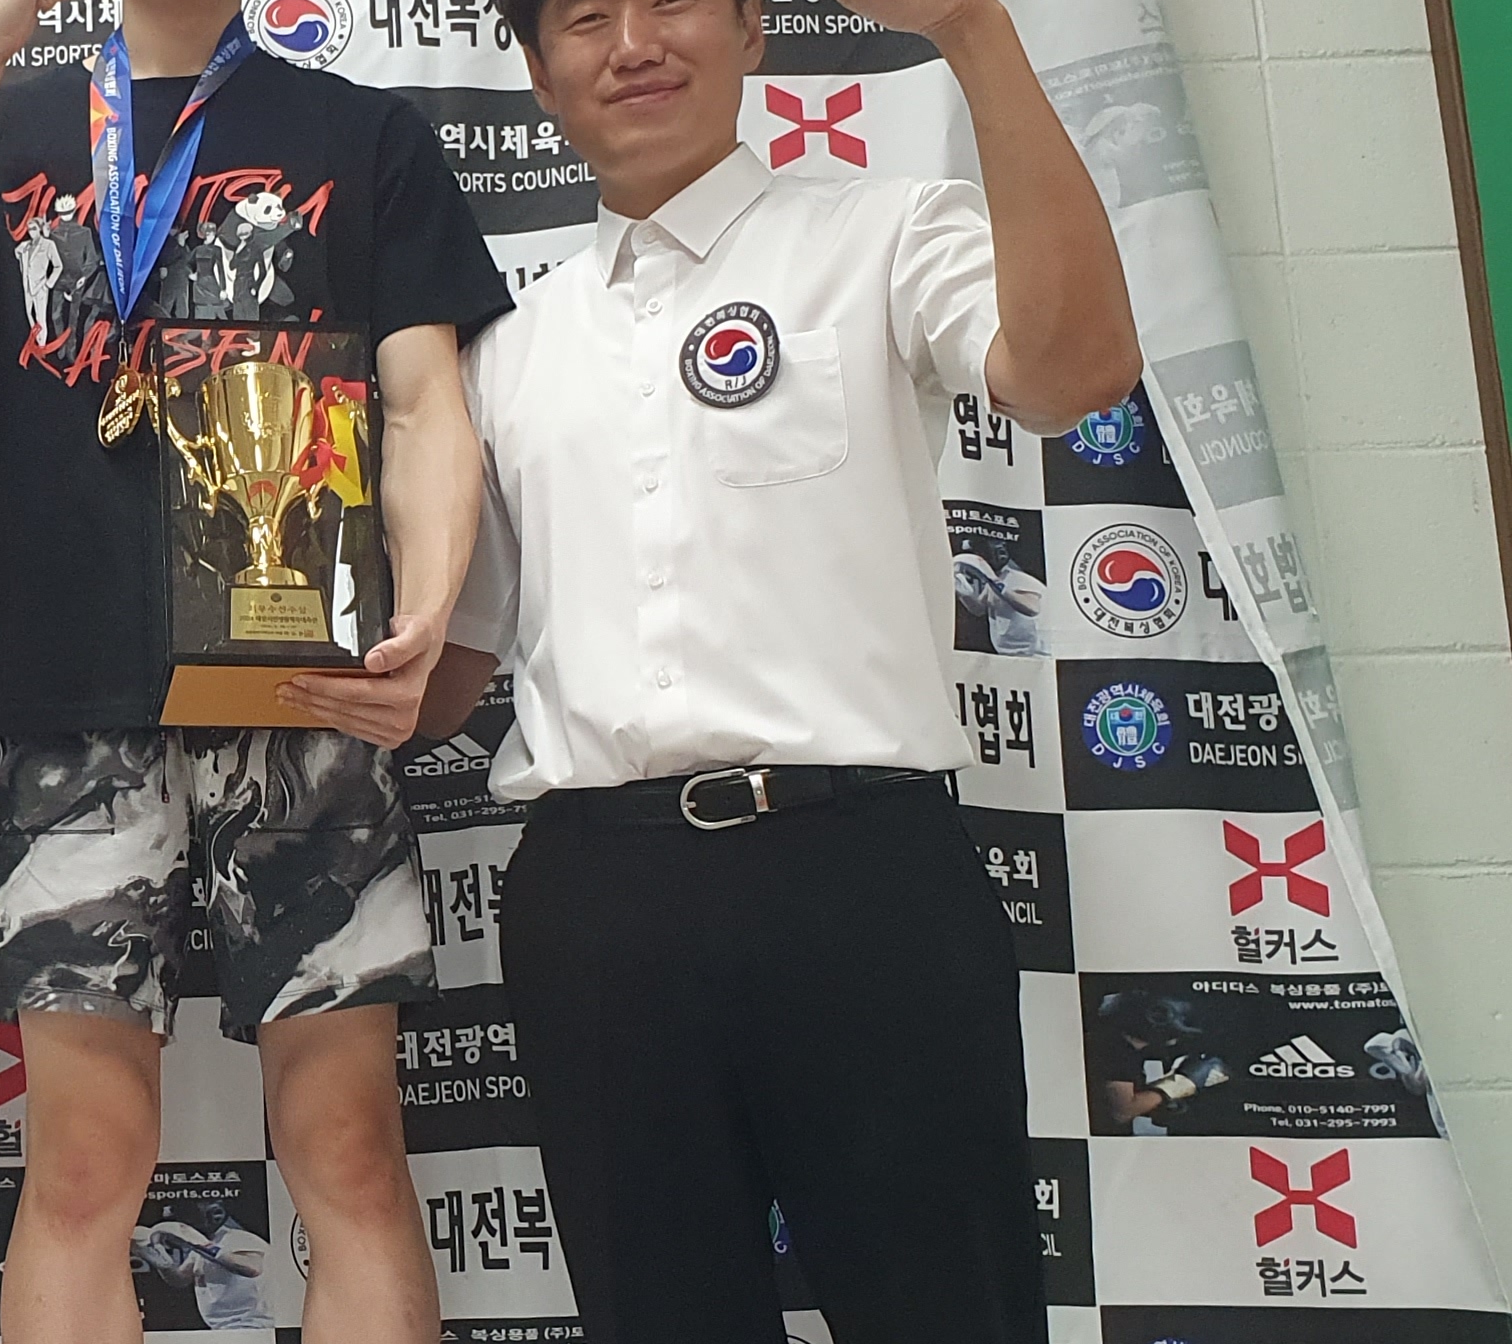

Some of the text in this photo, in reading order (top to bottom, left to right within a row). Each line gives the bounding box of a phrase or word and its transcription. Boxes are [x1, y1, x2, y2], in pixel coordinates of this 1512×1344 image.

[106, 127, 117, 162] BOXING
[511, 162, 596, 192] COUNCIL
[107, 164, 119, 231] ASSOCIATION
[1190, 743, 1277, 766] DAEJEON
[1231, 926, 1339, 964] 헐커스
[1193, 981, 1341, 996] 아디다스 복싱용품
[1250, 1062, 1355, 1077] adidas
[1288, 1104, 1395, 1114] 010-5140-7991
[1295, 1118, 1397, 1128] 031-295-7993
[1256, 1257, 1367, 1298] 헐커스
